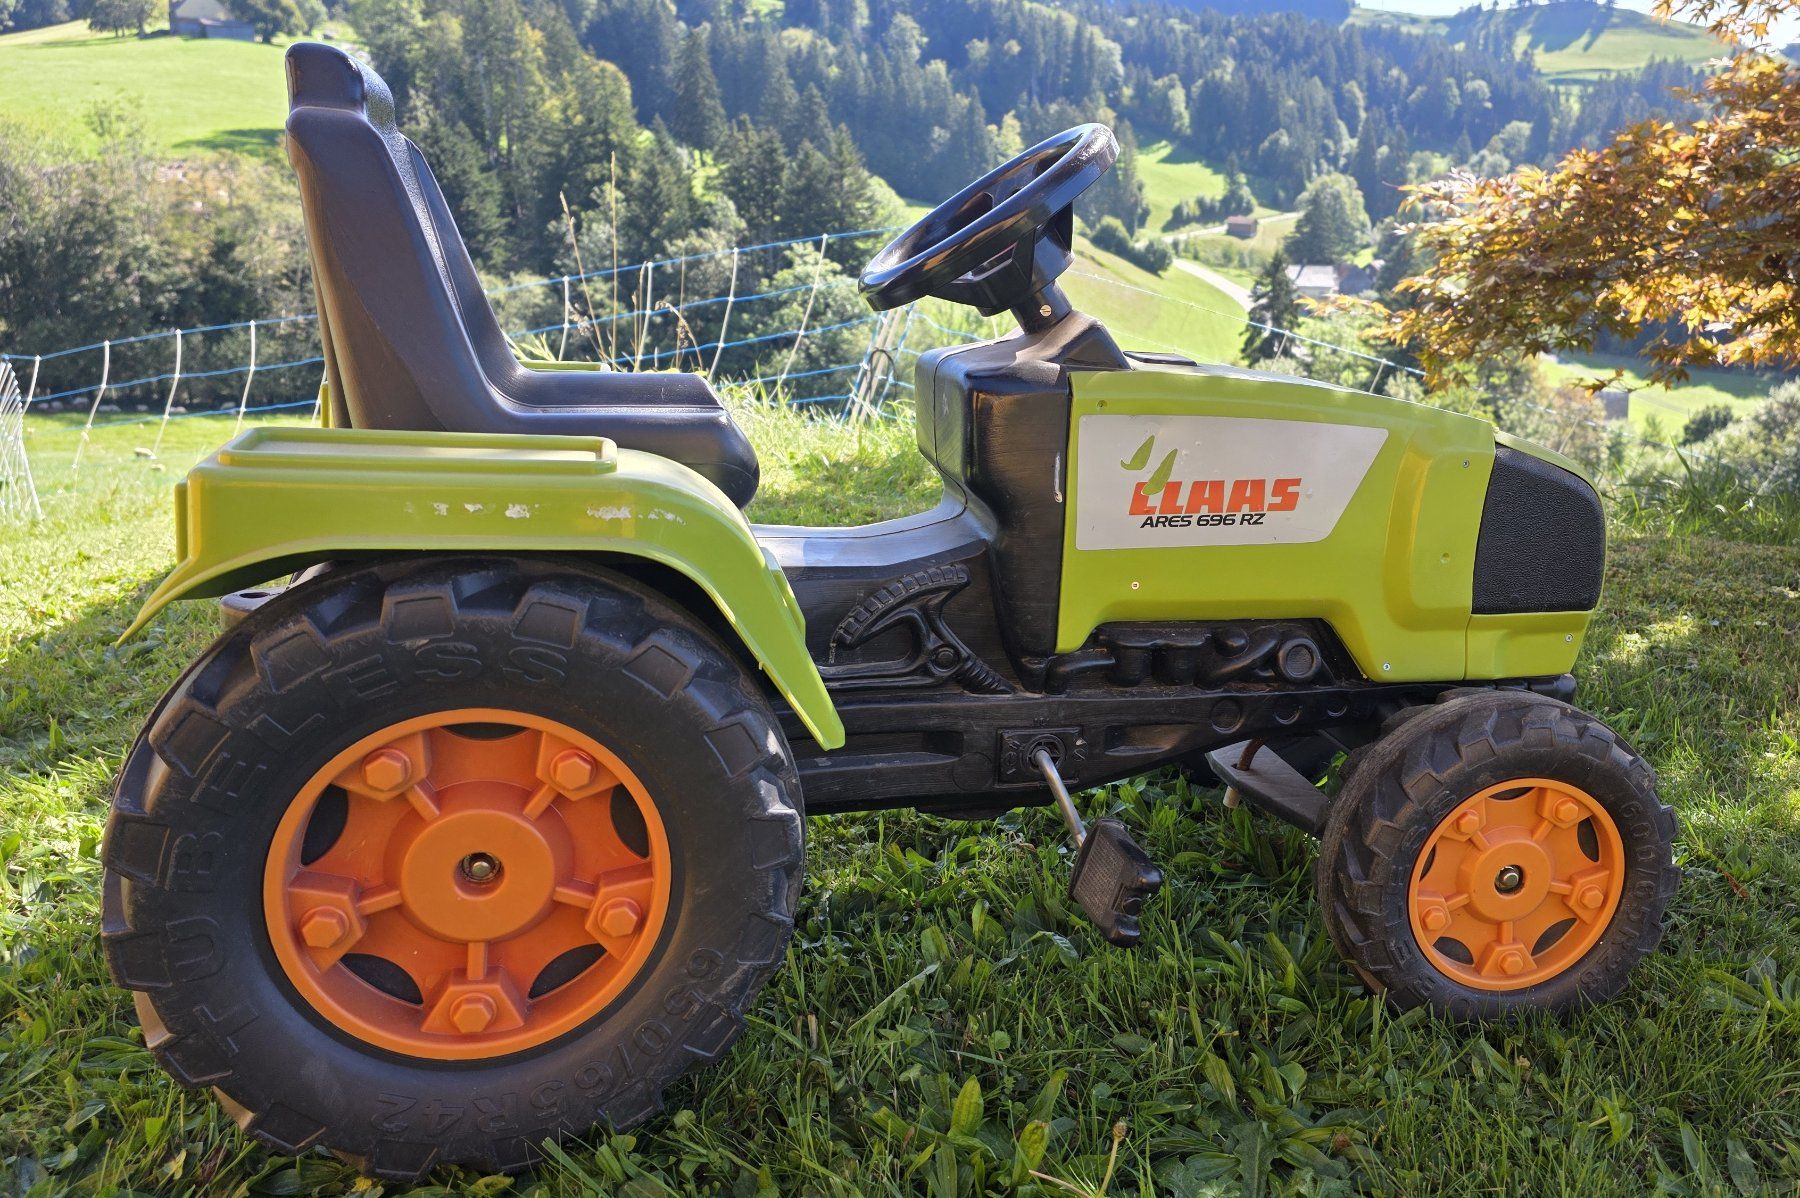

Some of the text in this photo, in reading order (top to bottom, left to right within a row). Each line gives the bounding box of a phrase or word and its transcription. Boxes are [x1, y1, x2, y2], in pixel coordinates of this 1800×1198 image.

[1129, 477, 1302, 516] CLAAS
[1140, 512, 1267, 529] ARES 696 RZ
[164, 641, 569, 1058] TUBELESS
[371, 947, 725, 1134] 650/65R42
